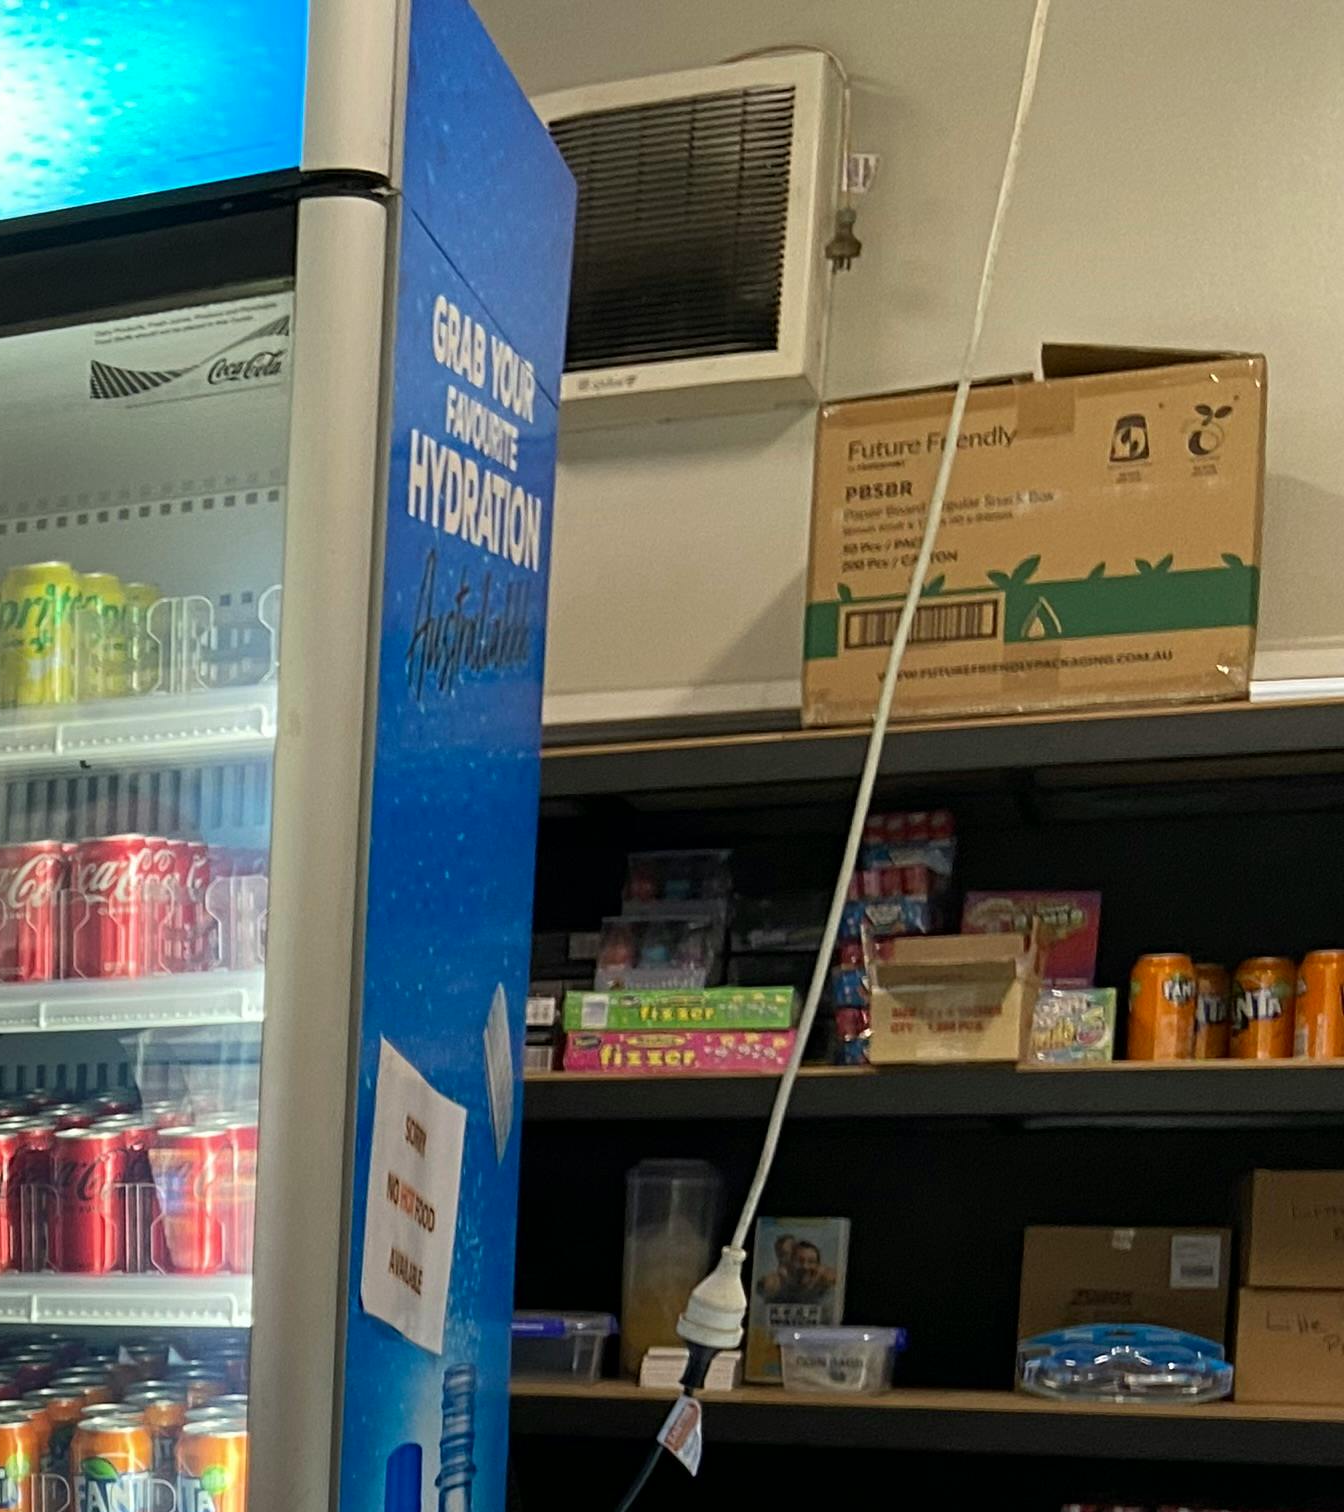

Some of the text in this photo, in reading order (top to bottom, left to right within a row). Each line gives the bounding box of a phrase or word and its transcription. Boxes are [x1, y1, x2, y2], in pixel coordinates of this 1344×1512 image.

[432, 295, 534, 423] GRAB YOUR
[446, 386, 518, 470] FAVOURITE
[848, 425, 1017, 461] Future Frendly
[408, 430, 542, 572] HYDRATION
[600, 1045, 696, 1066] fizzer
[414, 1197, 435, 1233] FOOD
